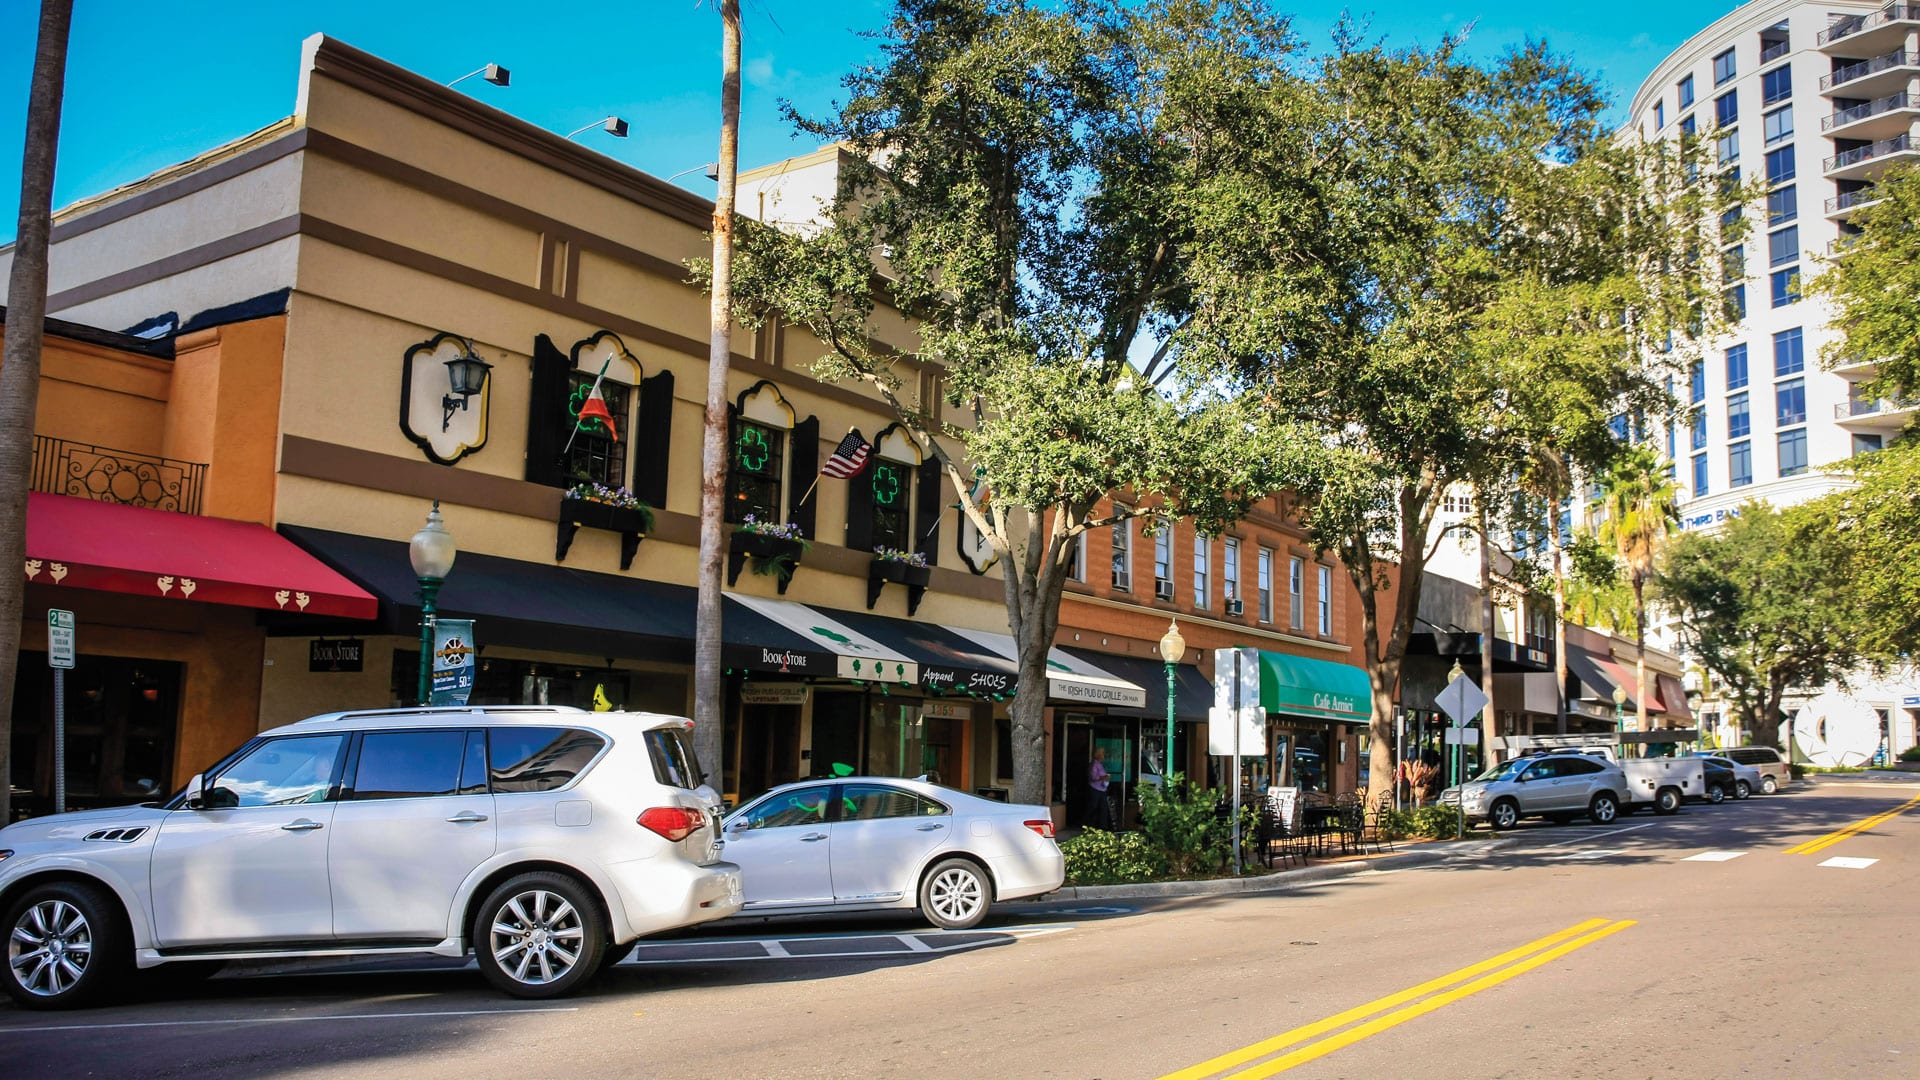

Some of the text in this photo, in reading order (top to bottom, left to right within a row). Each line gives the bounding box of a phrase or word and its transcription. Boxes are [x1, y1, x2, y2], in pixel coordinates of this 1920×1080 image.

[1685, 514, 1712, 529] THIRD
[50, 612, 58, 624] 2
[336, 641, 359, 660] STORE
[762, 648, 783, 664] BOOK
[786, 650, 807, 666] STORE
[922, 668, 954, 684] Apparel
[969, 673, 1006, 690] SHOES
[1068, 686, 1083, 696] IRISH
[1084, 688, 1096, 698] PUB
[1102, 690, 1121, 701] GRILLE
[1313, 693, 1330, 709] Cafe
